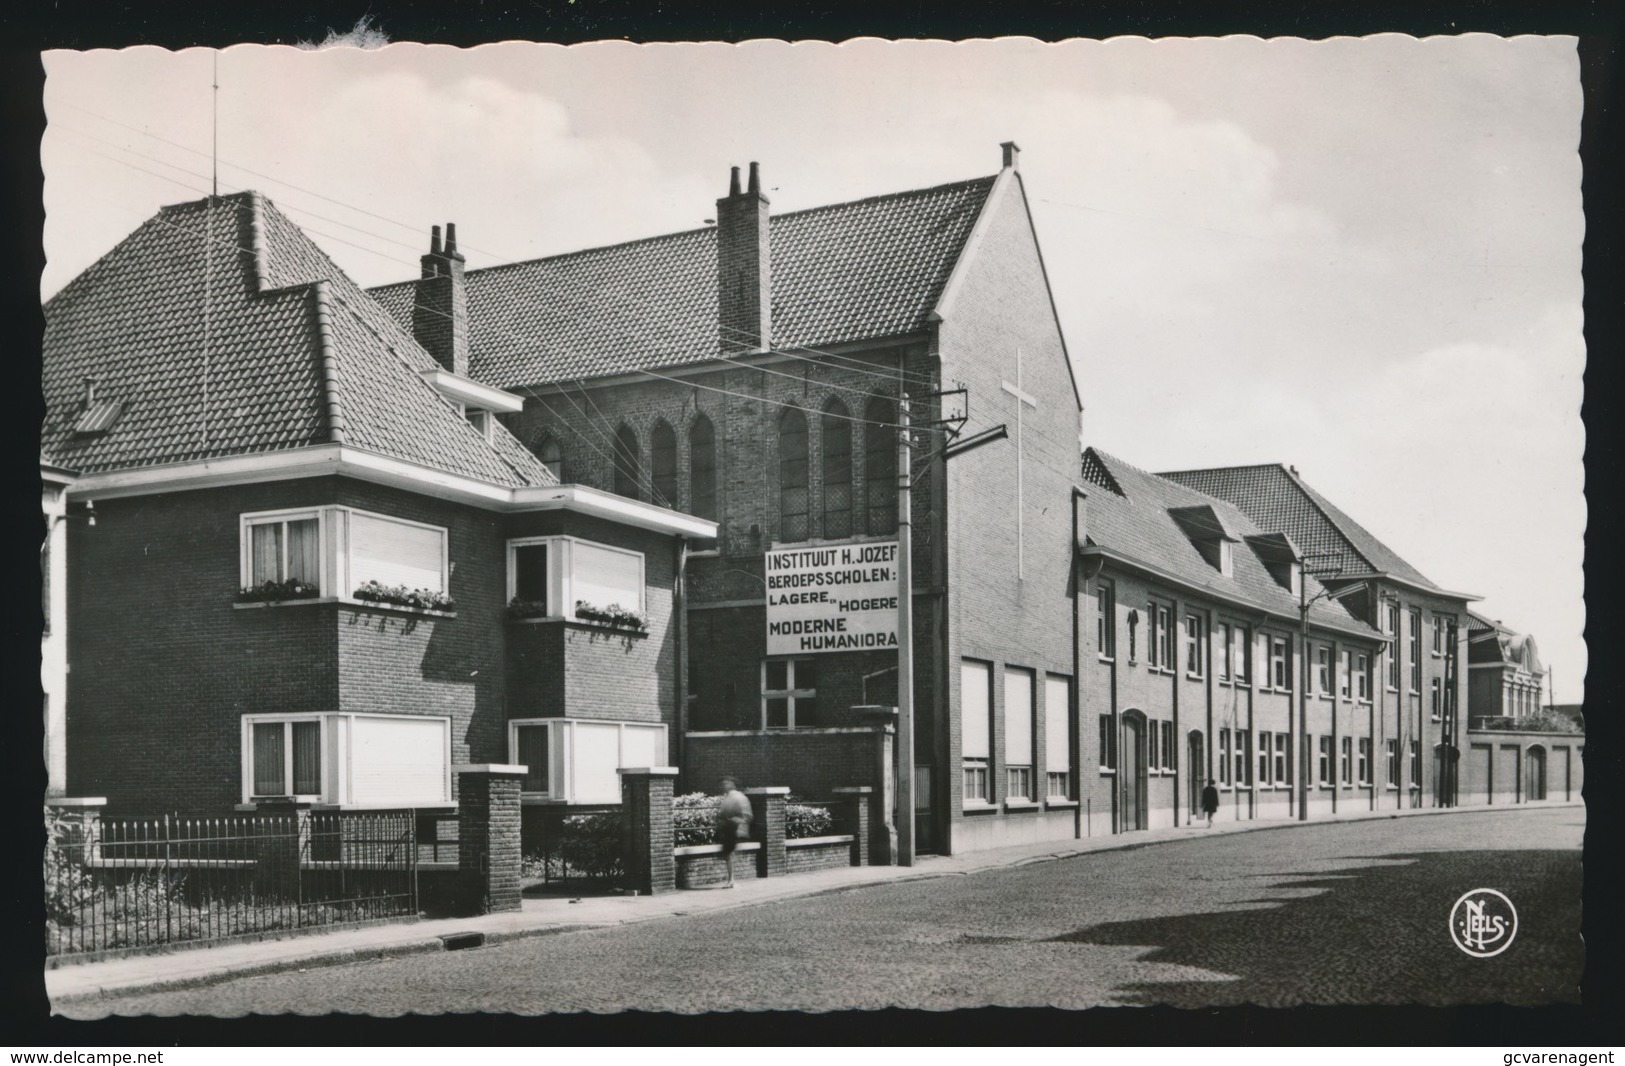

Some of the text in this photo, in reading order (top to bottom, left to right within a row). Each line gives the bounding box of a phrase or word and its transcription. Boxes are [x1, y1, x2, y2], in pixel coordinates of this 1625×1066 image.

[768, 549, 838, 571] INSTITUUT
[768, 567, 897, 590] BEROEPSSCHOLEN:
[769, 591, 829, 606] LAGERE
[839, 597, 898, 613] HOGERE
[769, 618, 847, 636] MODERNE
[800, 631, 898, 650] HUMANIORA
